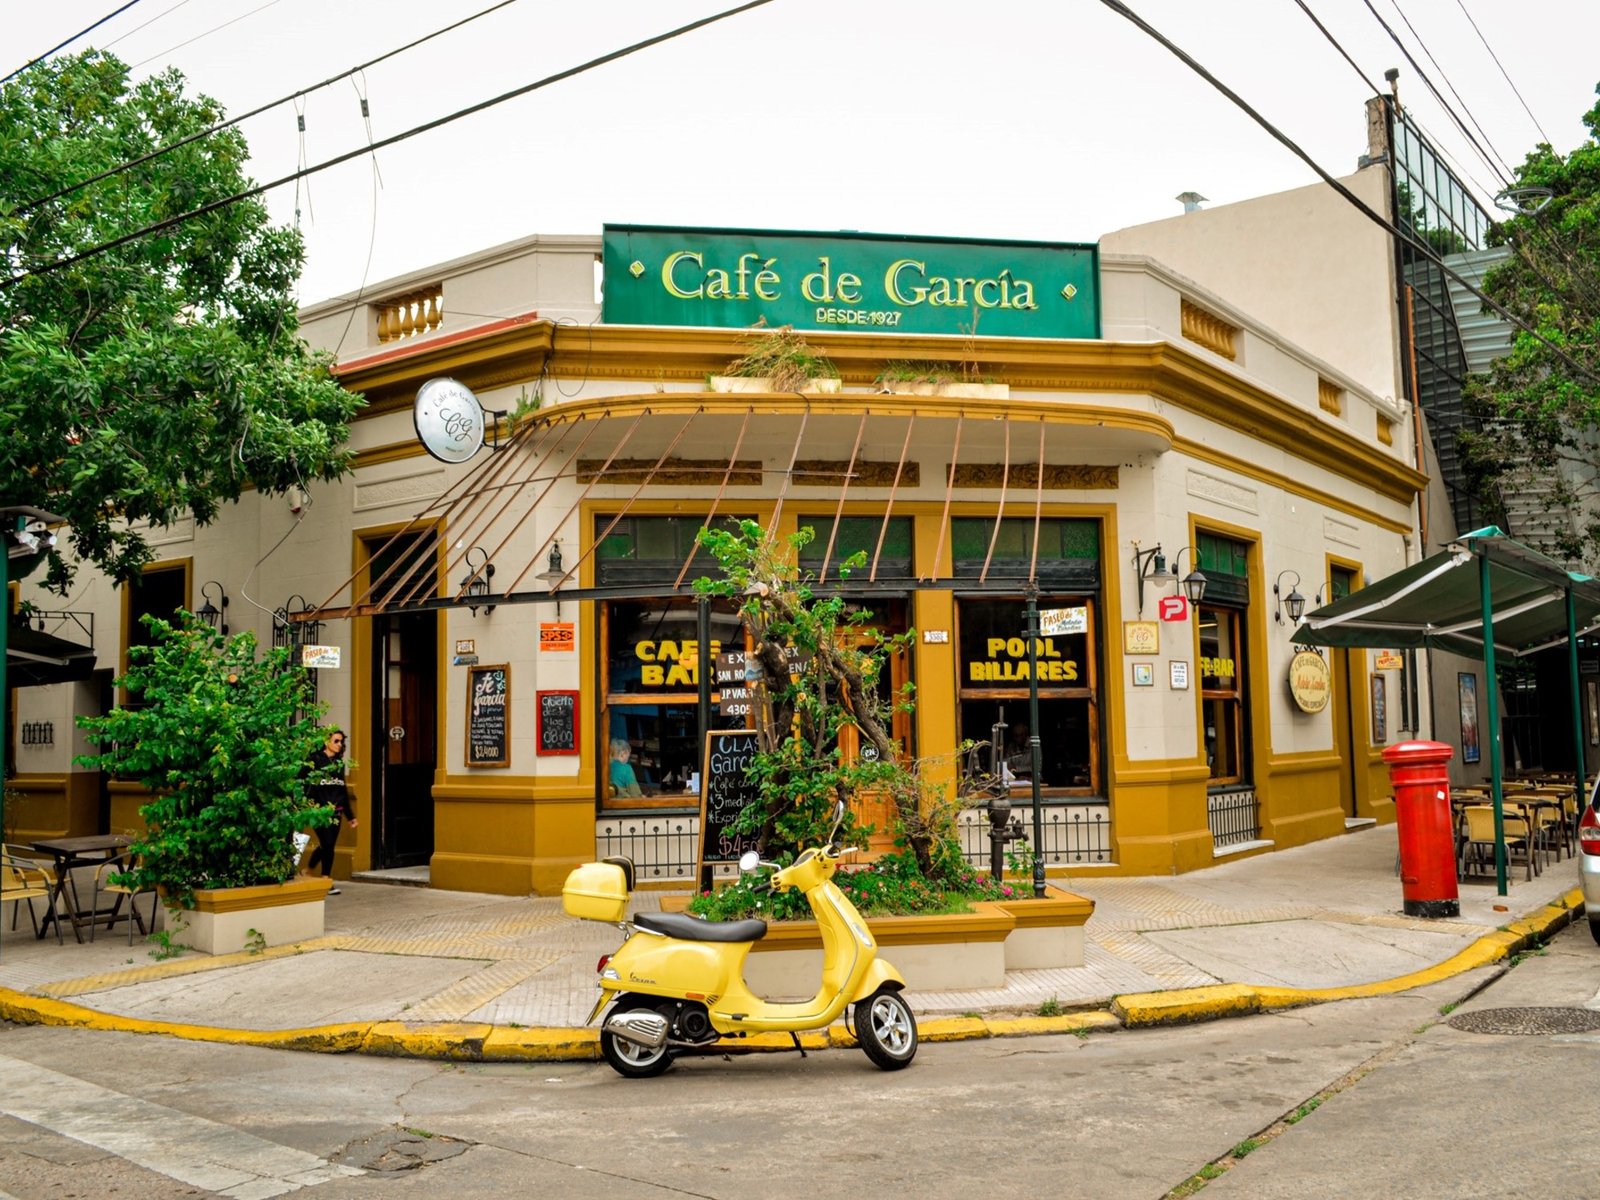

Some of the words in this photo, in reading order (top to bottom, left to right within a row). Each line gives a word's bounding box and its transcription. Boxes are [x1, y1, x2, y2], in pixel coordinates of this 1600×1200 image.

[661, 251, 781, 301] Café
[801, 256, 863, 303] de
[884, 259, 1039, 310] García
[816, 307, 867, 324] DESDE
[1043, 611, 1064, 627] PASEO
[987, 637, 1061, 658] POOL
[641, 665, 718, 685] BAR
[718, 670, 731, 681] SAN
[734, 669, 745, 681] RO
[969, 660, 1078, 681] BILLARES
[727, 703, 752, 715] 4305
[714, 793, 725, 809] 3
[725, 792, 754, 808] medial
